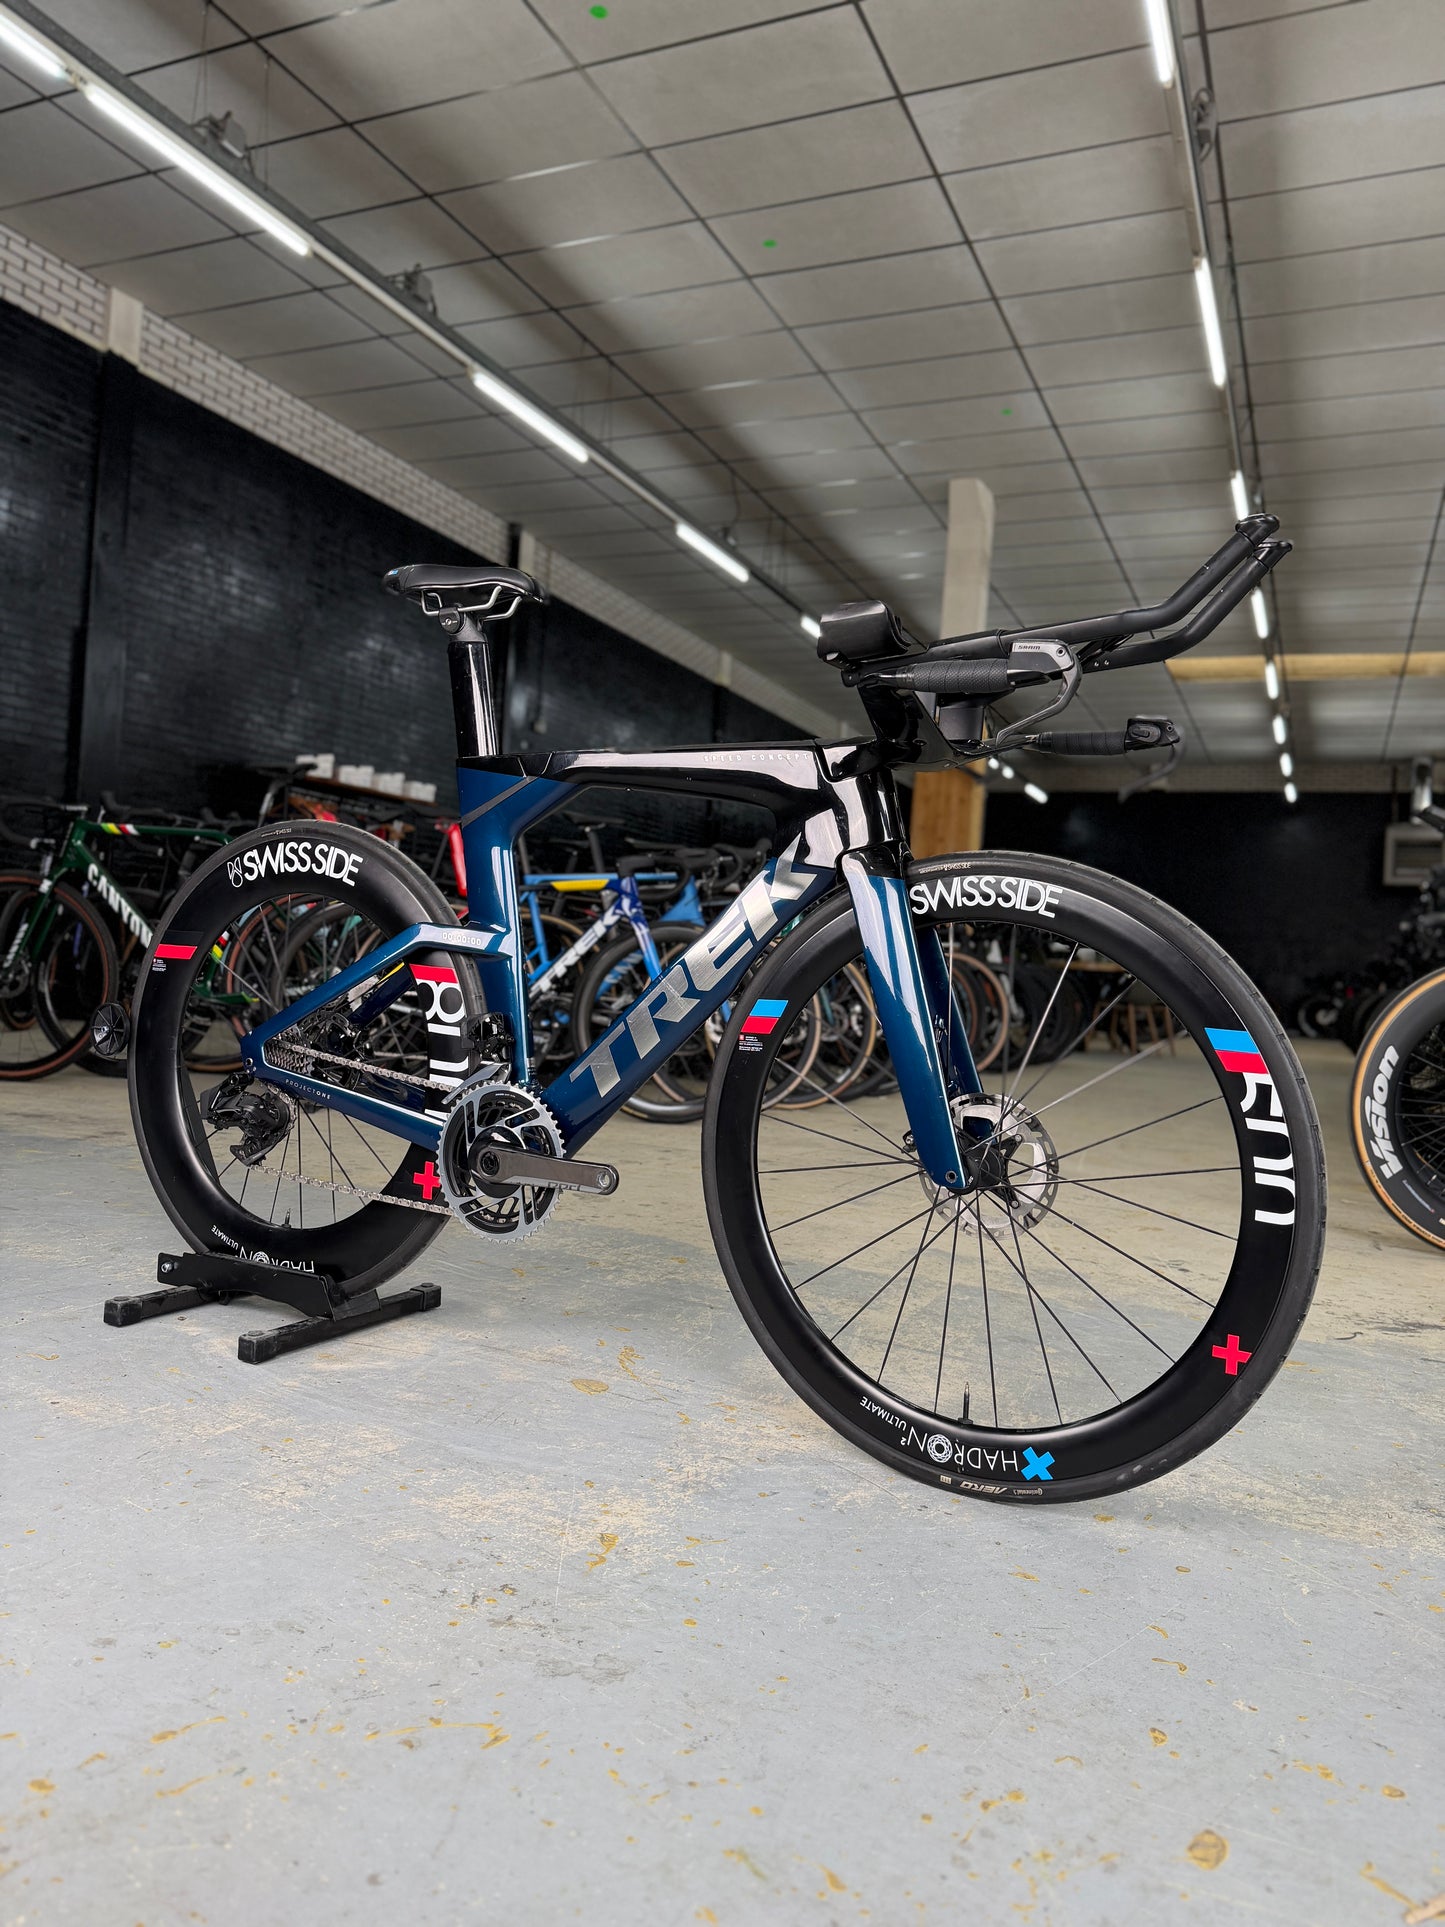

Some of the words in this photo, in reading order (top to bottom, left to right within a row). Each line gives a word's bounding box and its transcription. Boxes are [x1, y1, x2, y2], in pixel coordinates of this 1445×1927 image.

[751, 753, 809, 761] CONCEPT
[243, 841, 312, 881] SWISS
[311, 843, 364, 887] SIDE
[87, 862, 153, 949] CANYON
[909, 875, 997, 915] SWISS
[996, 876, 1063, 919] SIDE
[529, 903, 622, 999] TREK
[569, 832, 817, 1098] TREK
[211, 1224, 239, 1250] ULTIMATE
[859, 1396, 907, 1432] ULTIMATE
[960, 1480, 1008, 1495] AERO
